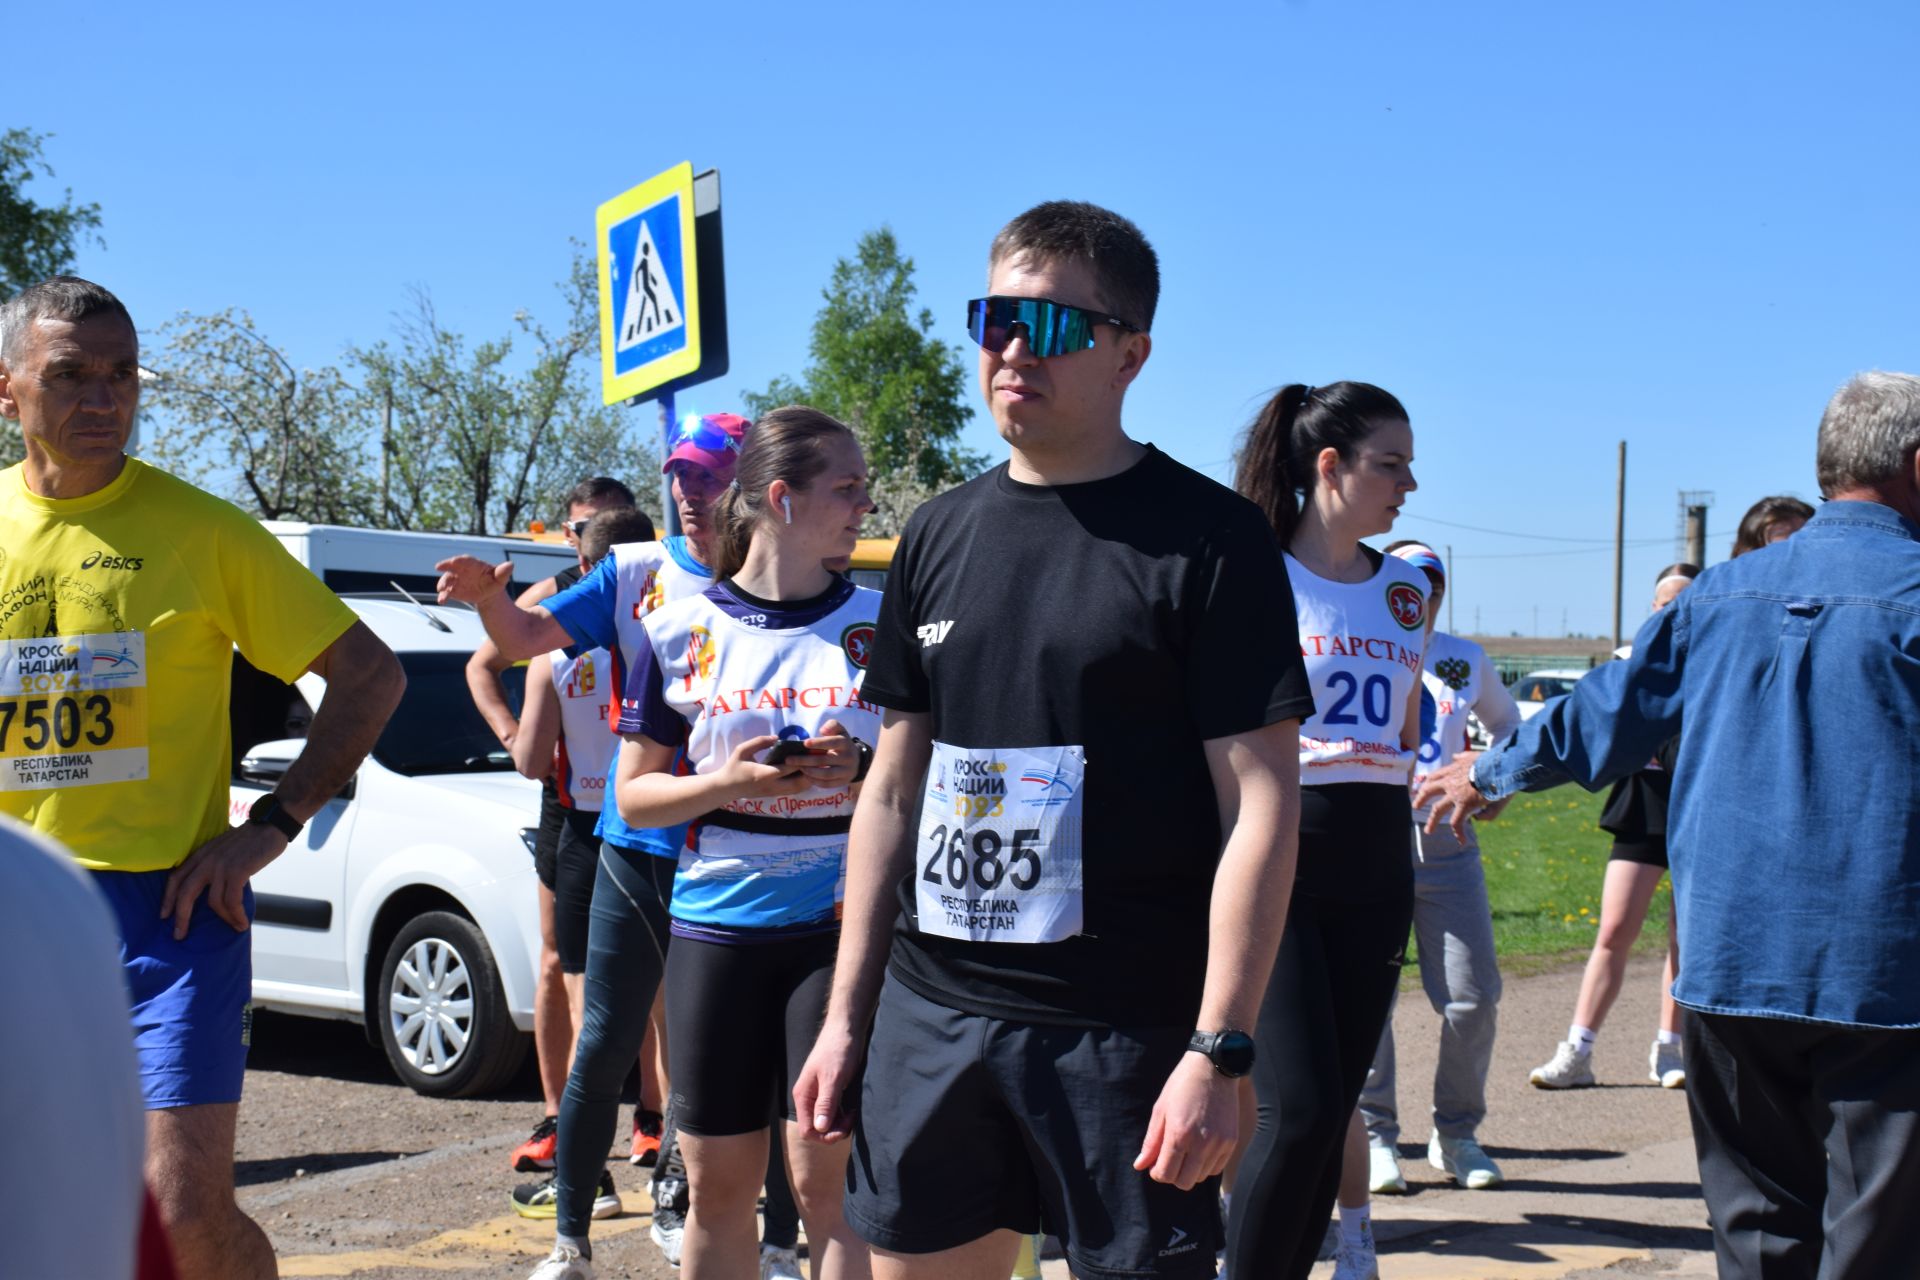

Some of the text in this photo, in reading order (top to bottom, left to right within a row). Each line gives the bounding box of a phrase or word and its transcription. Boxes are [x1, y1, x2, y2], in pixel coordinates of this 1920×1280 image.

[18, 645, 64, 660] КРОСС
[19, 657, 79, 675] НАЦИИ
[21, 673, 81, 693] 2024
[1323, 670, 1392, 727] 20
[0, 694, 114, 753] 7503
[13, 754, 93, 771] РЕСПУБЛИКА
[953, 758, 989, 777] КРОСС
[18, 767, 89, 784] ТАТАРСТАН
[953, 777, 1005, 797] НАЦИИ
[923, 824, 1042, 891] 2685
[941, 894, 1020, 914] РЕСПУБЛИКА
[945, 911, 1016, 930] ТАТАРСТАН
